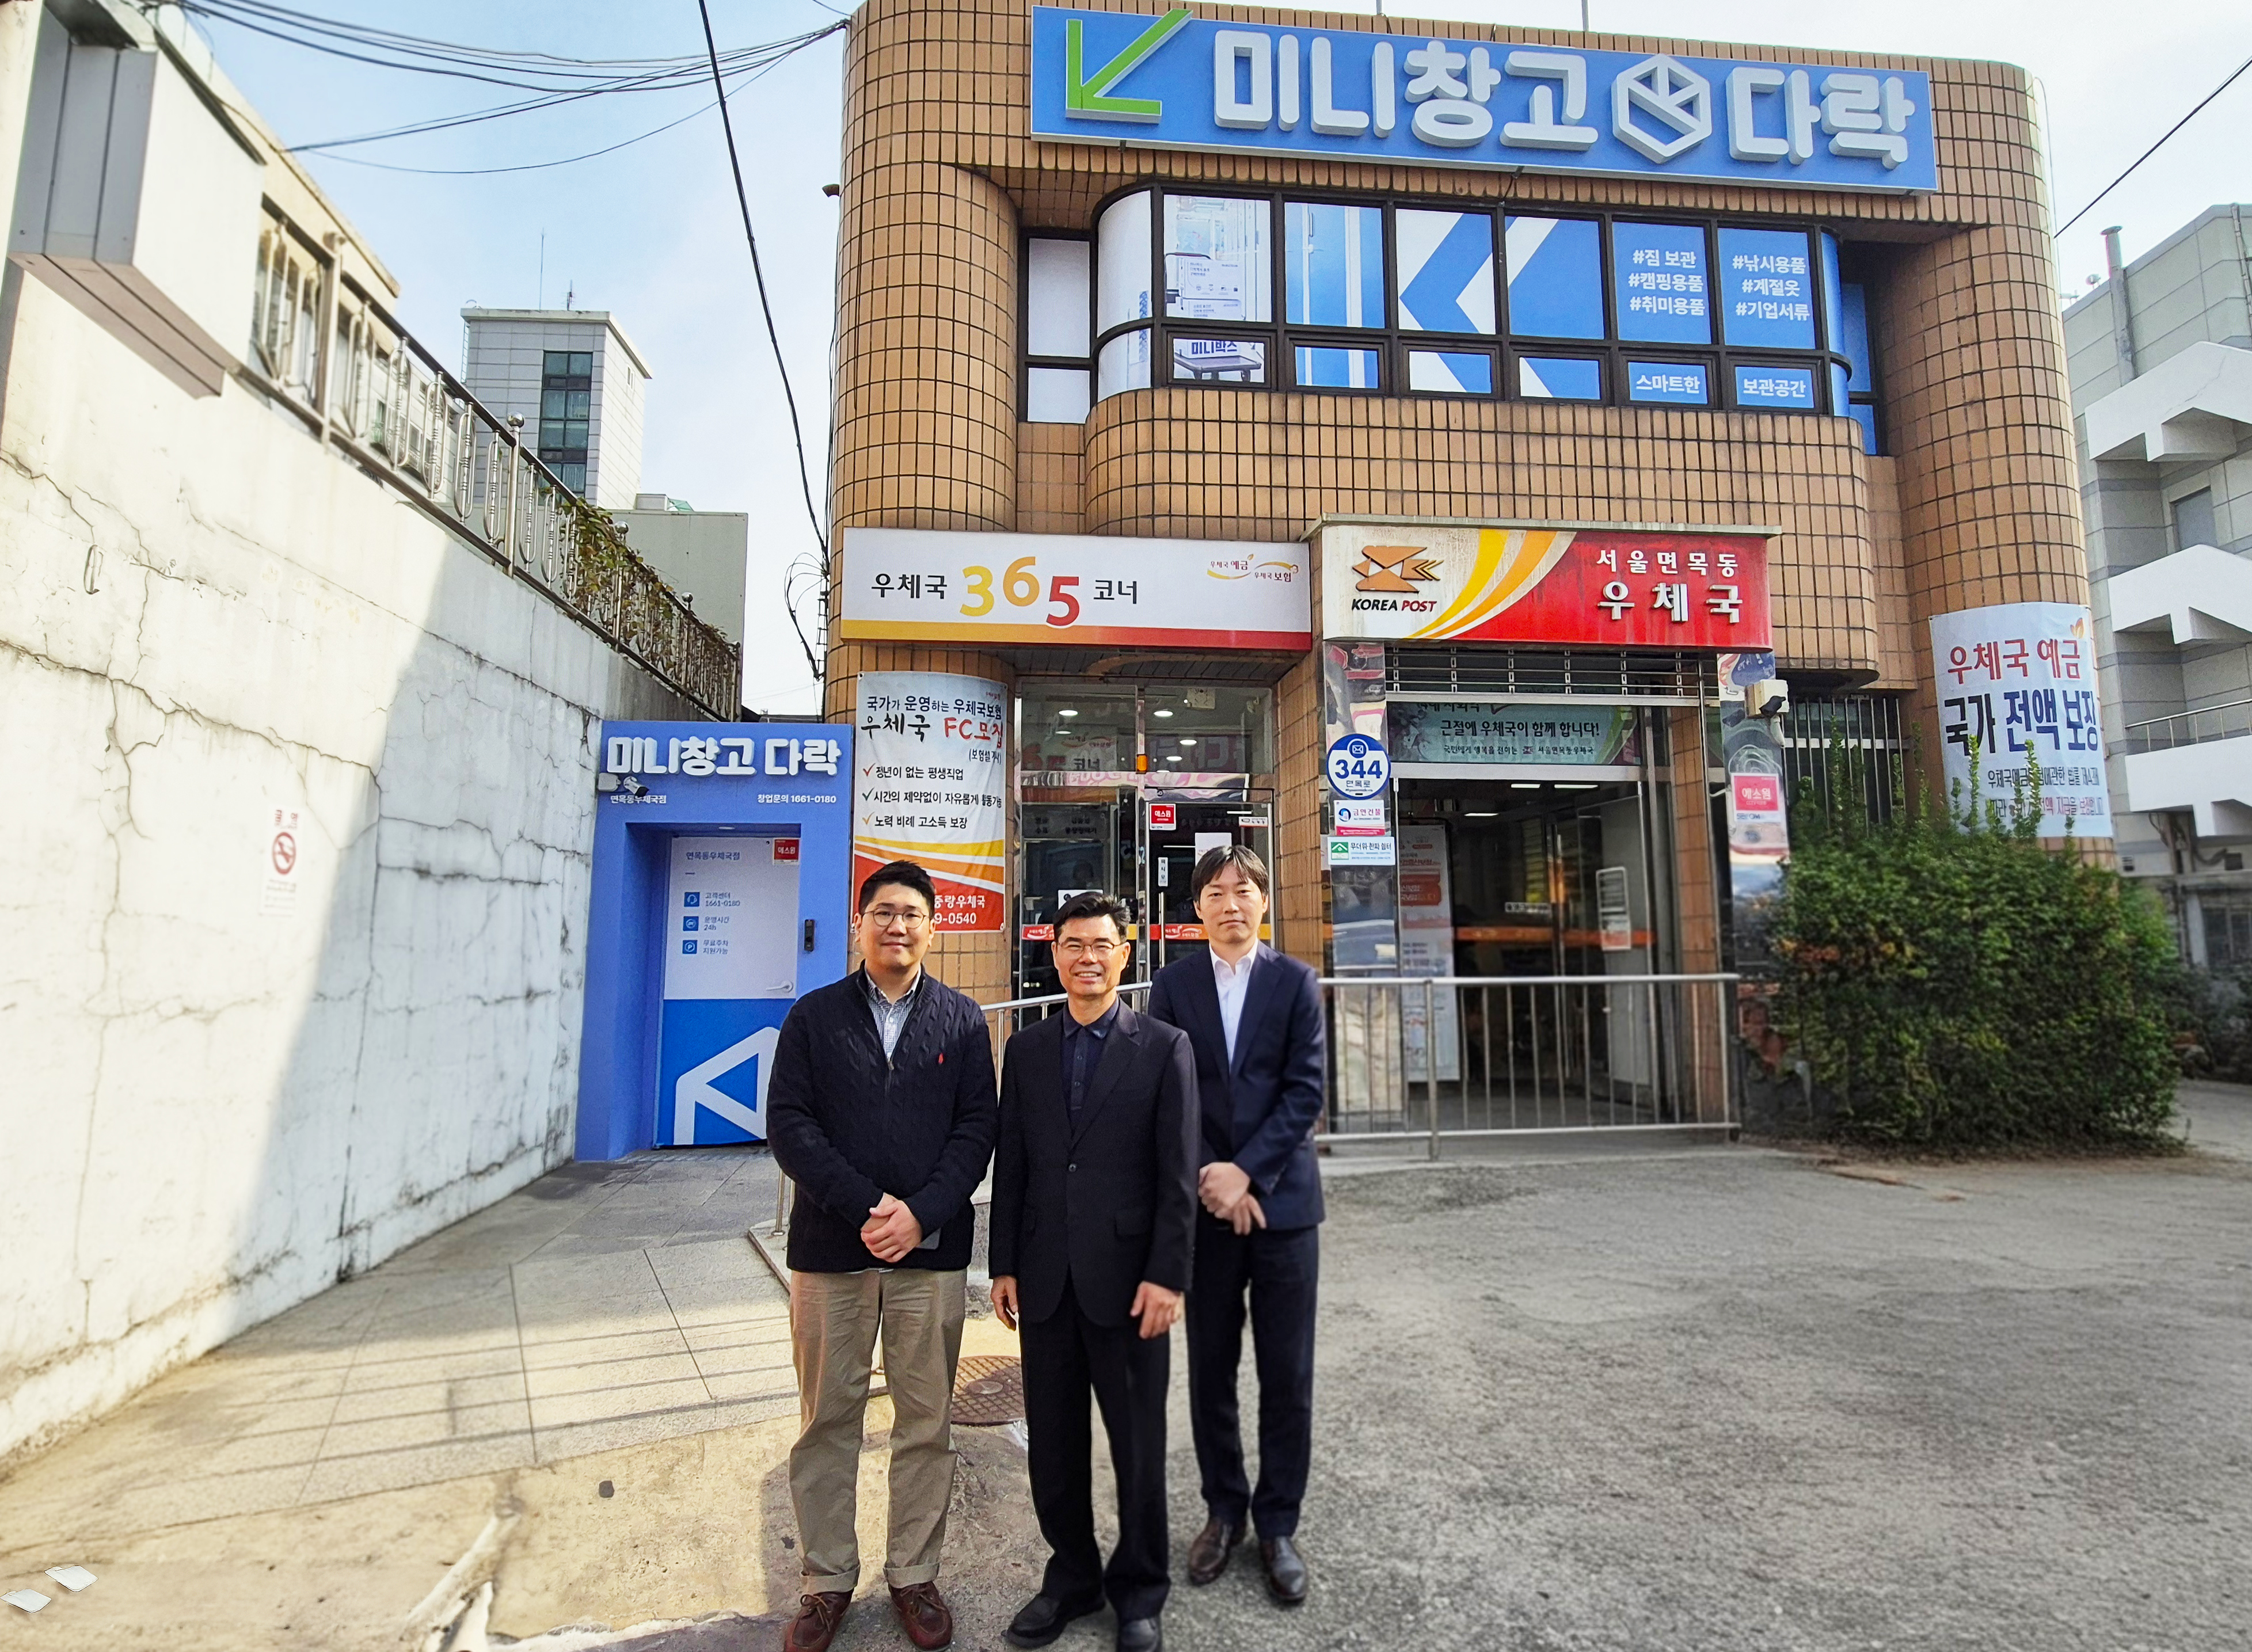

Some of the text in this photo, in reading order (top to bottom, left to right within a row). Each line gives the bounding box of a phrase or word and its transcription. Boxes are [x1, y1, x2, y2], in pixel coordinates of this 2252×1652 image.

[1214, 29, 1915, 170] 미니창고 다락
[1633, 249, 1696, 268] #짐 보관
[1732, 255, 1806, 275] #낚시용품
[1628, 272, 1703, 292] #캠핑용품
[1741, 278, 1801, 297] #계절옷
[1629, 296, 1705, 316] #취미용품
[1736, 302, 1810, 321] #기업서류
[1635, 374, 1701, 394] 스마트한
[1743, 378, 1806, 398] 보관공간
[1230, 560, 1248, 570] 예금
[1596, 550, 1739, 577] 서울면목동
[1274, 572, 1291, 583] 보험
[870, 556, 1138, 626] 우체국 365 코너
[1351, 598, 1437, 613] KOREA POST
[1598, 581, 1743, 624] 우체국
[1947, 638, 2080, 684] 우체국 예금
[867, 695, 1002, 720] 국가가 운영하는 우체국보험
[861, 713, 931, 743] 우체국
[1440, 720, 1600, 737] 근절에 우체국이 함께 합니다!
[1945, 688, 2098, 756] 국가 전액 보장
[607, 736, 842, 776] 미니창고 다락
[876, 766, 964, 781] 정년이 없는 평생직업
[1335, 759, 1383, 779] 344
[758, 794, 789, 803] 창업문의
[790, 794, 836, 804] 1661-0180
[874, 790, 900, 803] 시간의
[904, 791, 941, 804] 제약없이
[945, 792, 979, 805] 자유롭게
[874, 816, 968, 829] 노력 비례 고소득 보장
